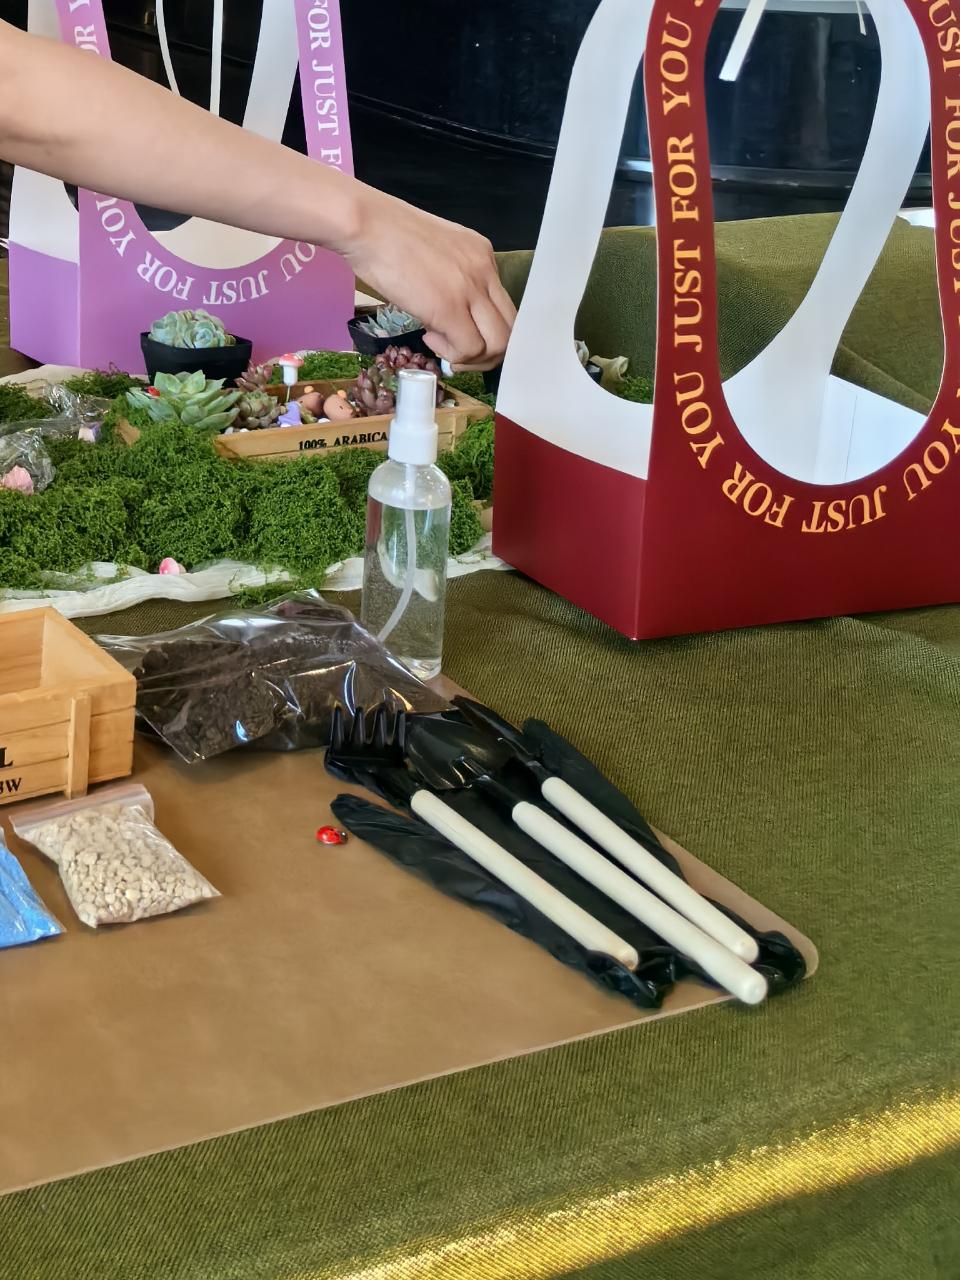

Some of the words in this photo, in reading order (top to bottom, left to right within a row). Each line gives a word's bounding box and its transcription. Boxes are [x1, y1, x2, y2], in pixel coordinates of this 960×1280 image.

[659, 12, 692, 116] YOU
[312, 59, 342, 137] JUST
[666, 132, 702, 222] FOR
[136, 251, 195, 301] FOR
[203, 269, 269, 305] JUST
[280, 241, 317, 282] OU
[674, 239, 702, 352] JUST
[298, 438, 328, 451] 100%
[333, 431, 388, 446] ARABICA
[673, 371, 725, 469] YOU
[721, 461, 795, 528] FOR
[801, 485, 887, 533] JUST
